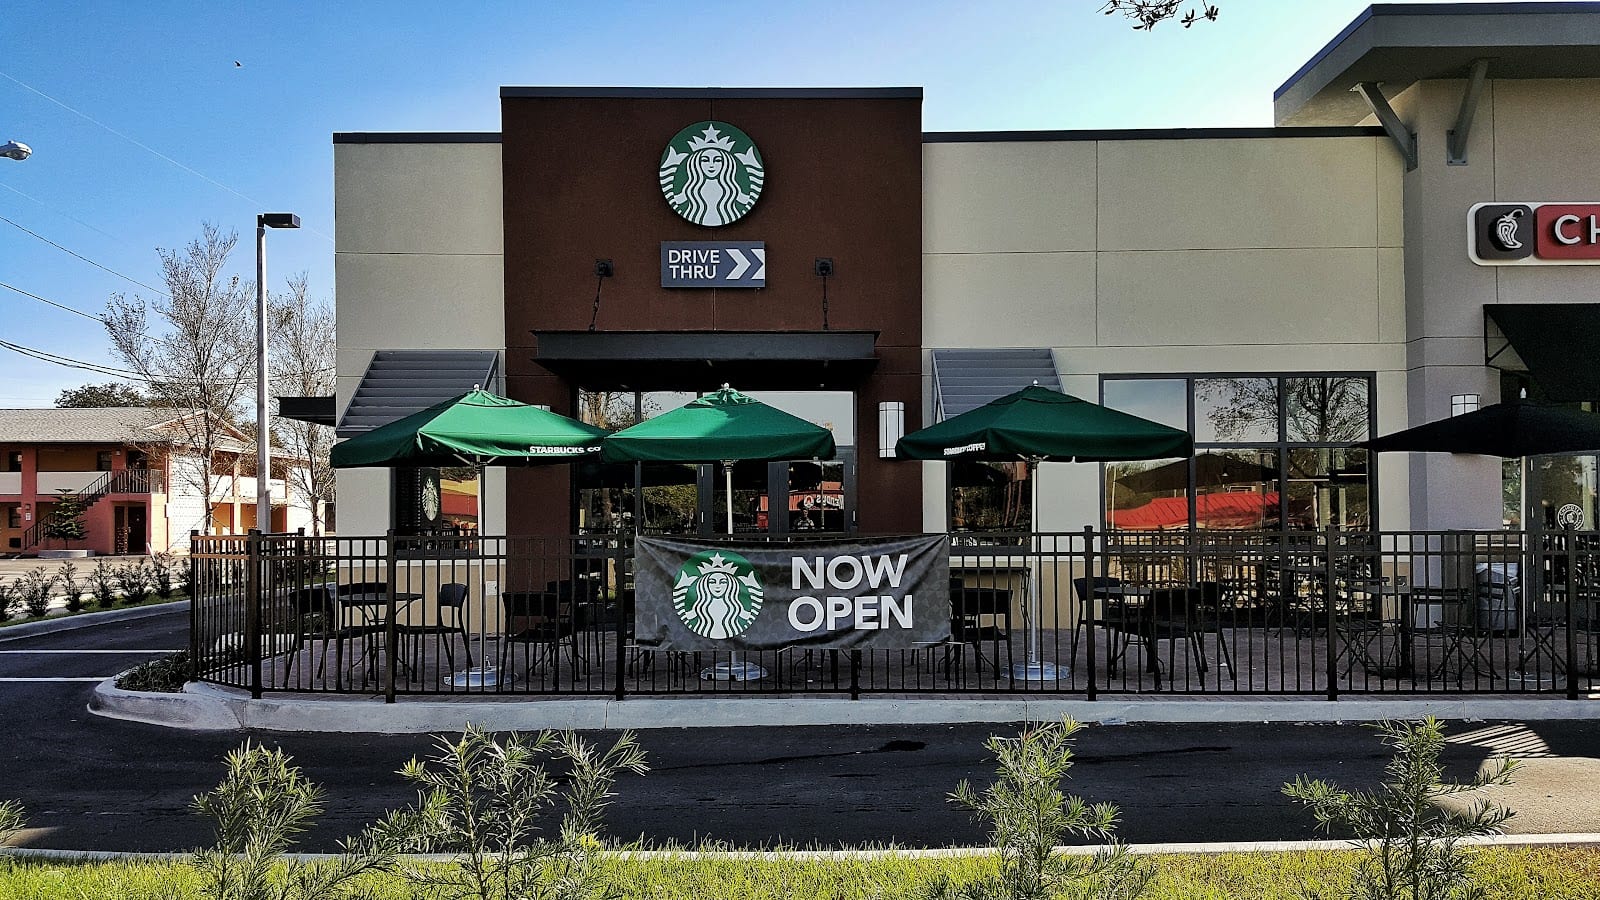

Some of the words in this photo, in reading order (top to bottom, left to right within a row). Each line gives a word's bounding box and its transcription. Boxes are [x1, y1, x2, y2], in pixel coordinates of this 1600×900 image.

[669, 250, 720, 263] DRIVE
[669, 265, 717, 279] THRU
[530, 446, 585, 454] STARBUCKS
[791, 554, 908, 590] NOW
[787, 594, 913, 631] OPEN
